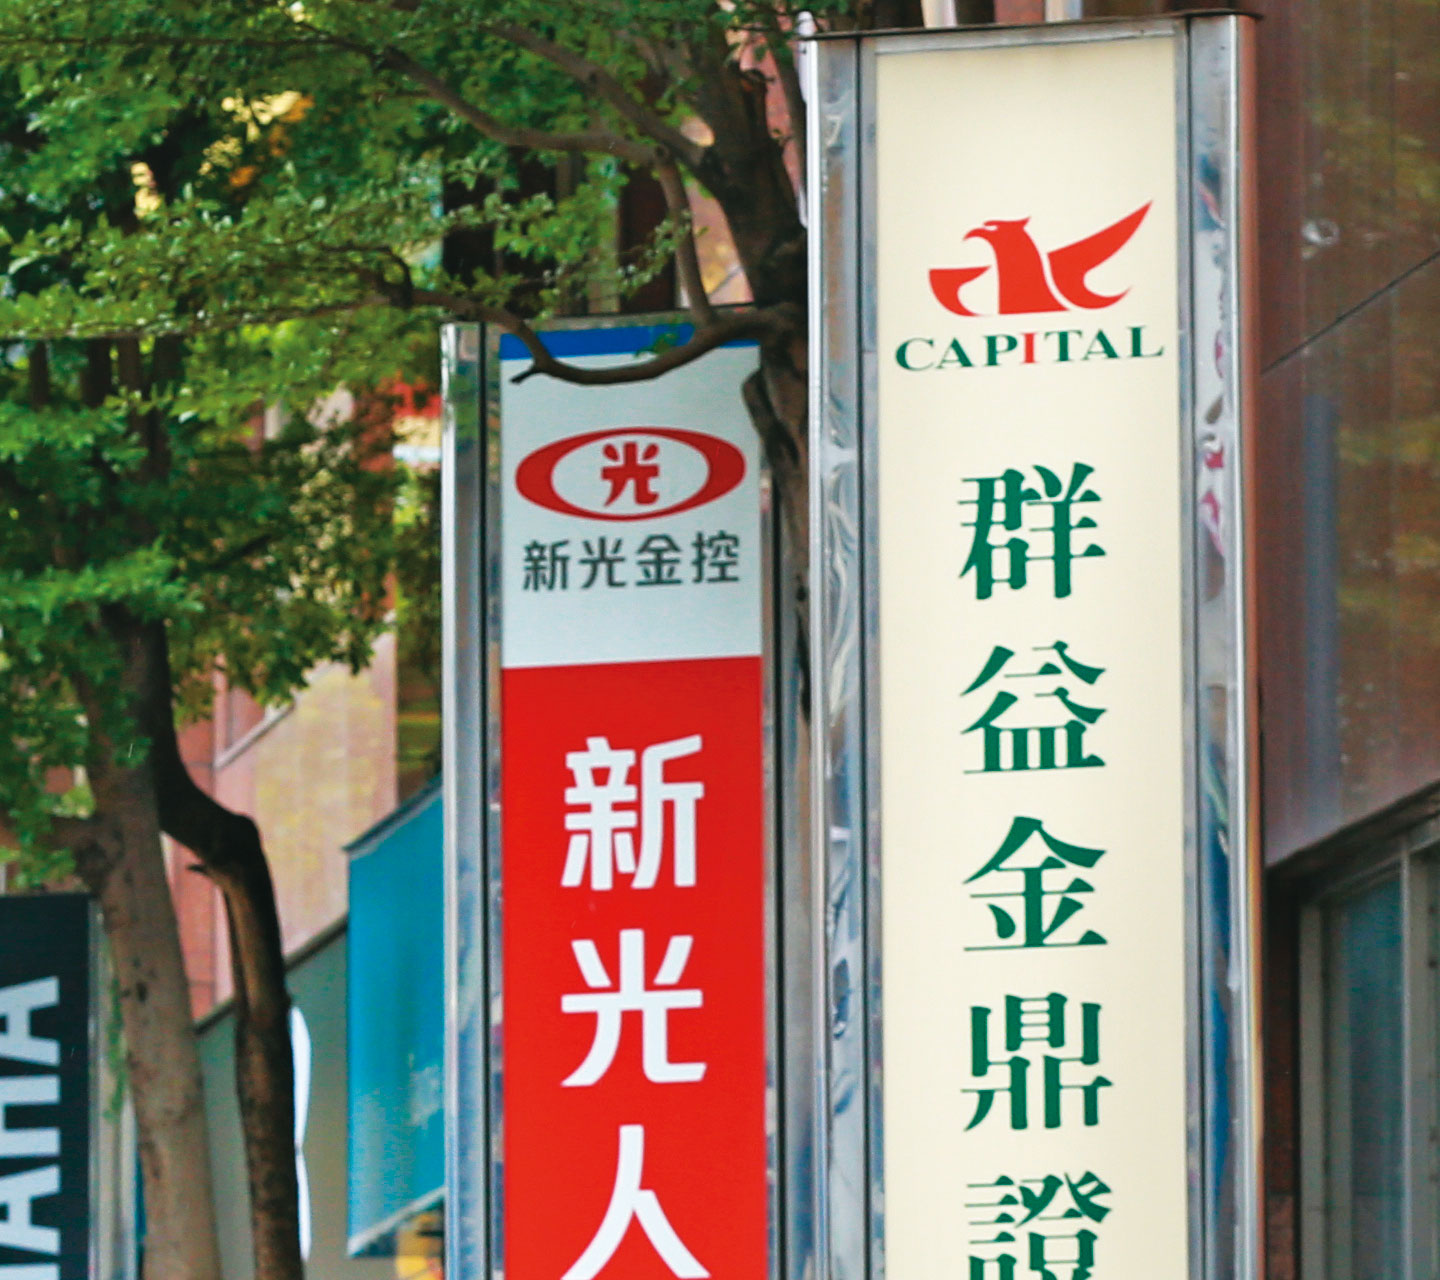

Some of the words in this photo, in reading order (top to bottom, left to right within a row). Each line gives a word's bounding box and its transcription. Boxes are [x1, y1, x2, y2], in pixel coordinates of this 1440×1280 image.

[894, 325, 1165, 374] CAPITAL
[521, 530, 741, 593] 新光金控
